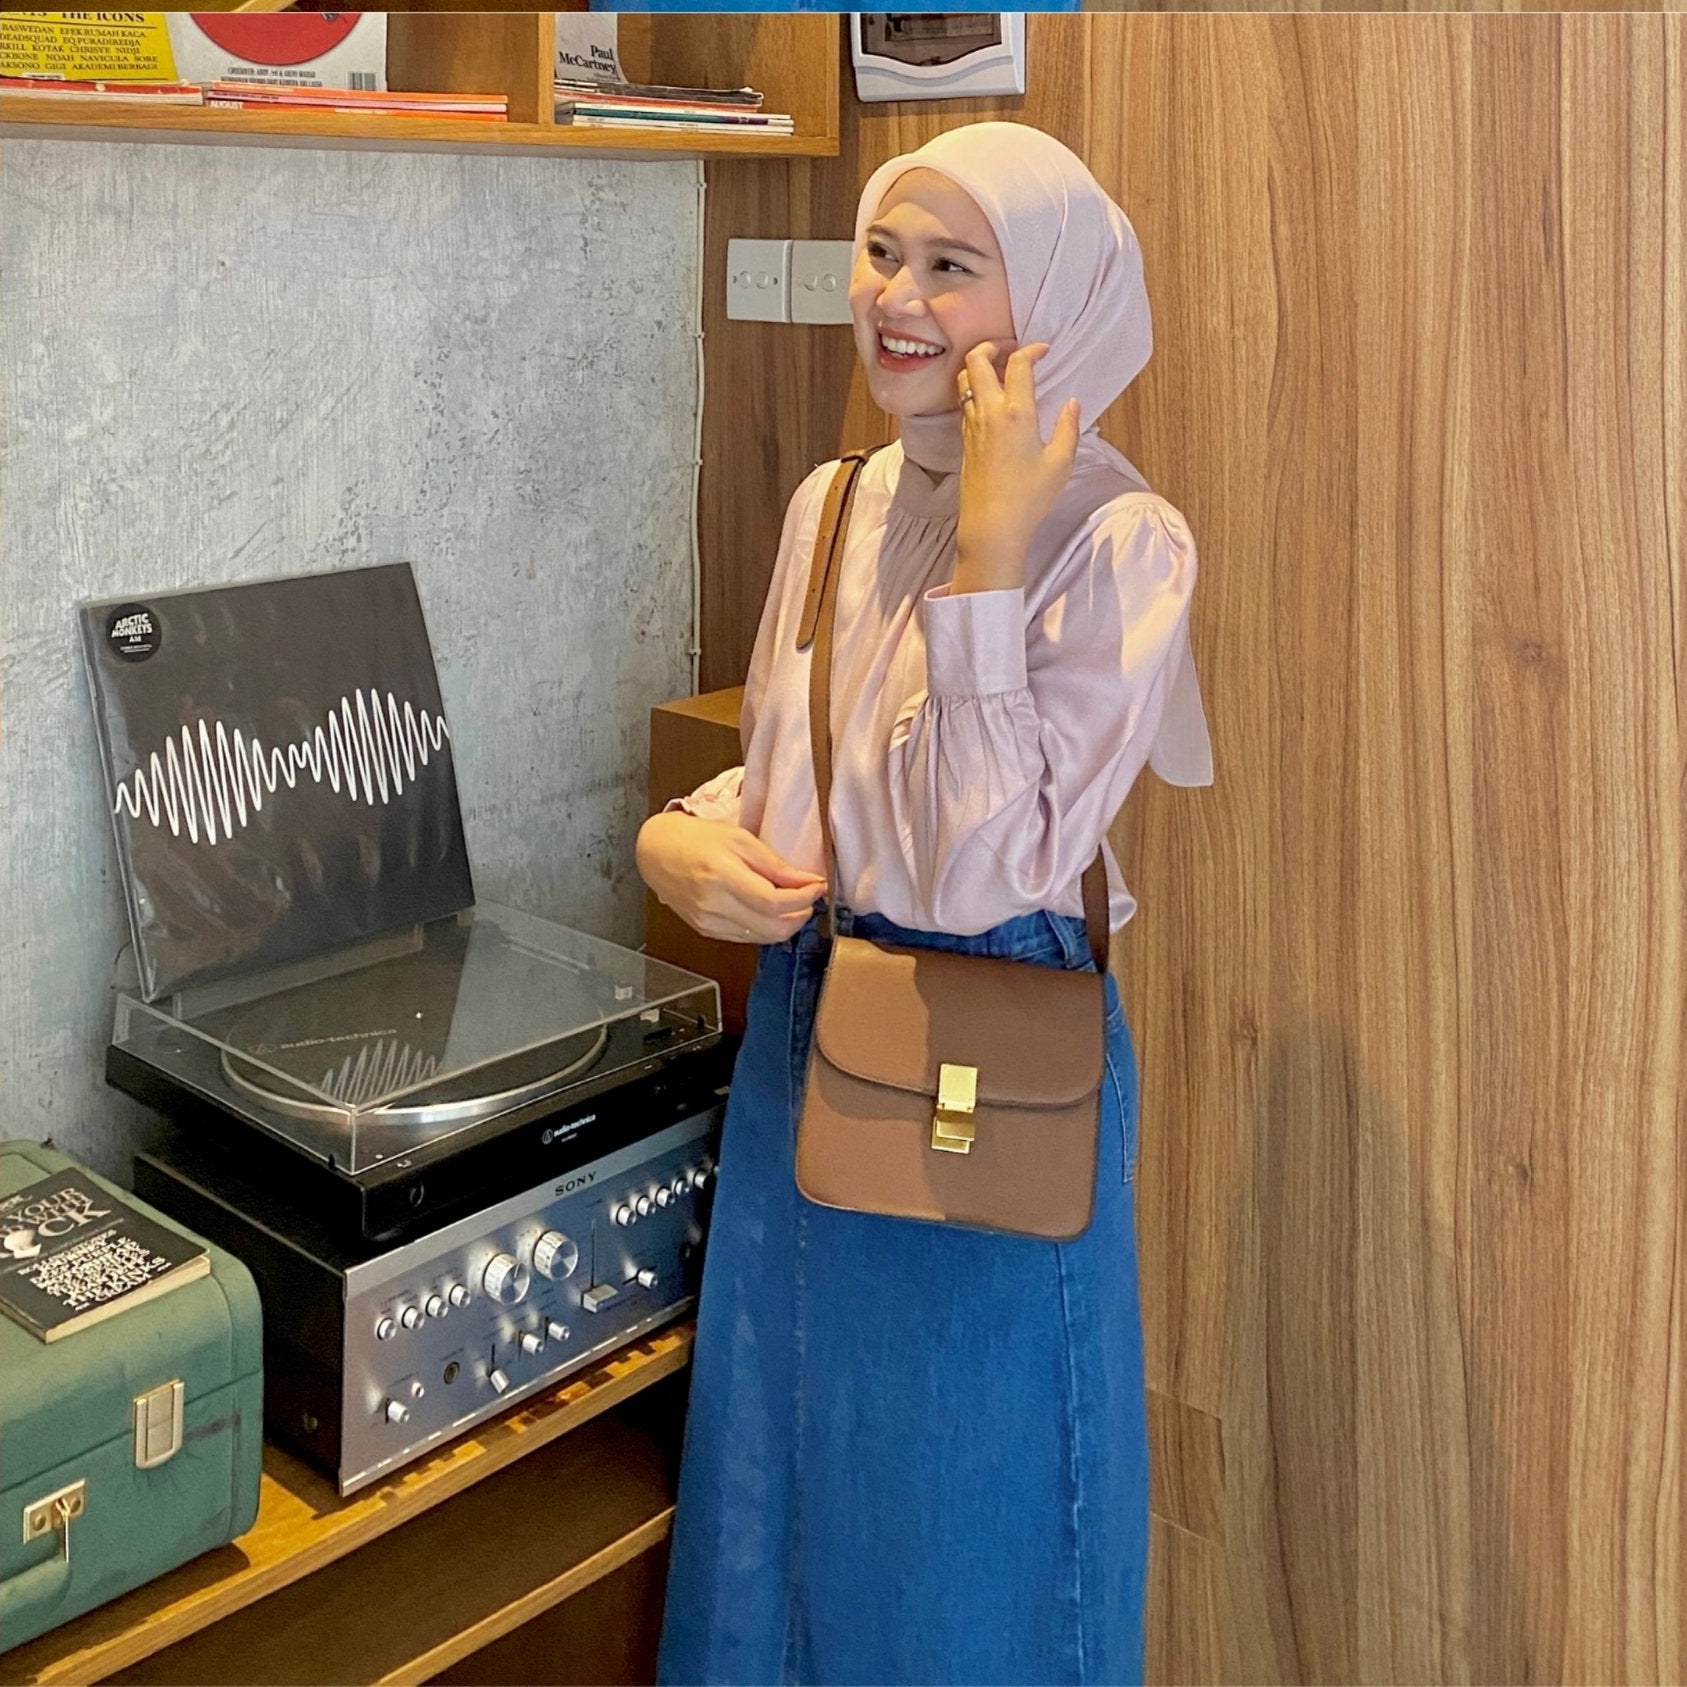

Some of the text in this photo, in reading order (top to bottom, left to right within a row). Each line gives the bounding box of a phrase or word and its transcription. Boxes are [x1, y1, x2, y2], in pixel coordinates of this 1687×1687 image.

[2, 24, 146, 38] BASWEDAN EFEK RUMAH KACA
[32, 45, 64, 53] KOTAK
[70, 46, 111, 54] CHRISYE
[116, 47, 140, 56] NIDJI
[63, 37, 77, 46] EQ
[77, 38, 141, 48] PURADIREDJA
[46, 54, 74, 62] NOAH
[80, 55, 129, 63] NAVICULA
[590, 44, 614, 60] Paul
[45, 62, 66, 71] GIGI
[71, 63, 116, 71] AKADEMI
[117, 63, 158, 71] BERBAGI
[558, 51, 617, 74] McCartney
[210, 100, 244, 110] AUGUST
[114, 612, 149, 630] ARCTIC
[111, 623, 153, 638] MONKEYS
[281, 1028, 397, 1049] audio-technica
[555, 1171, 597, 1197] SONY
[7, 1188, 76, 1223] YOUR
[27, 1193, 93, 1225] WITH
[38, 1199, 111, 1237] CK
